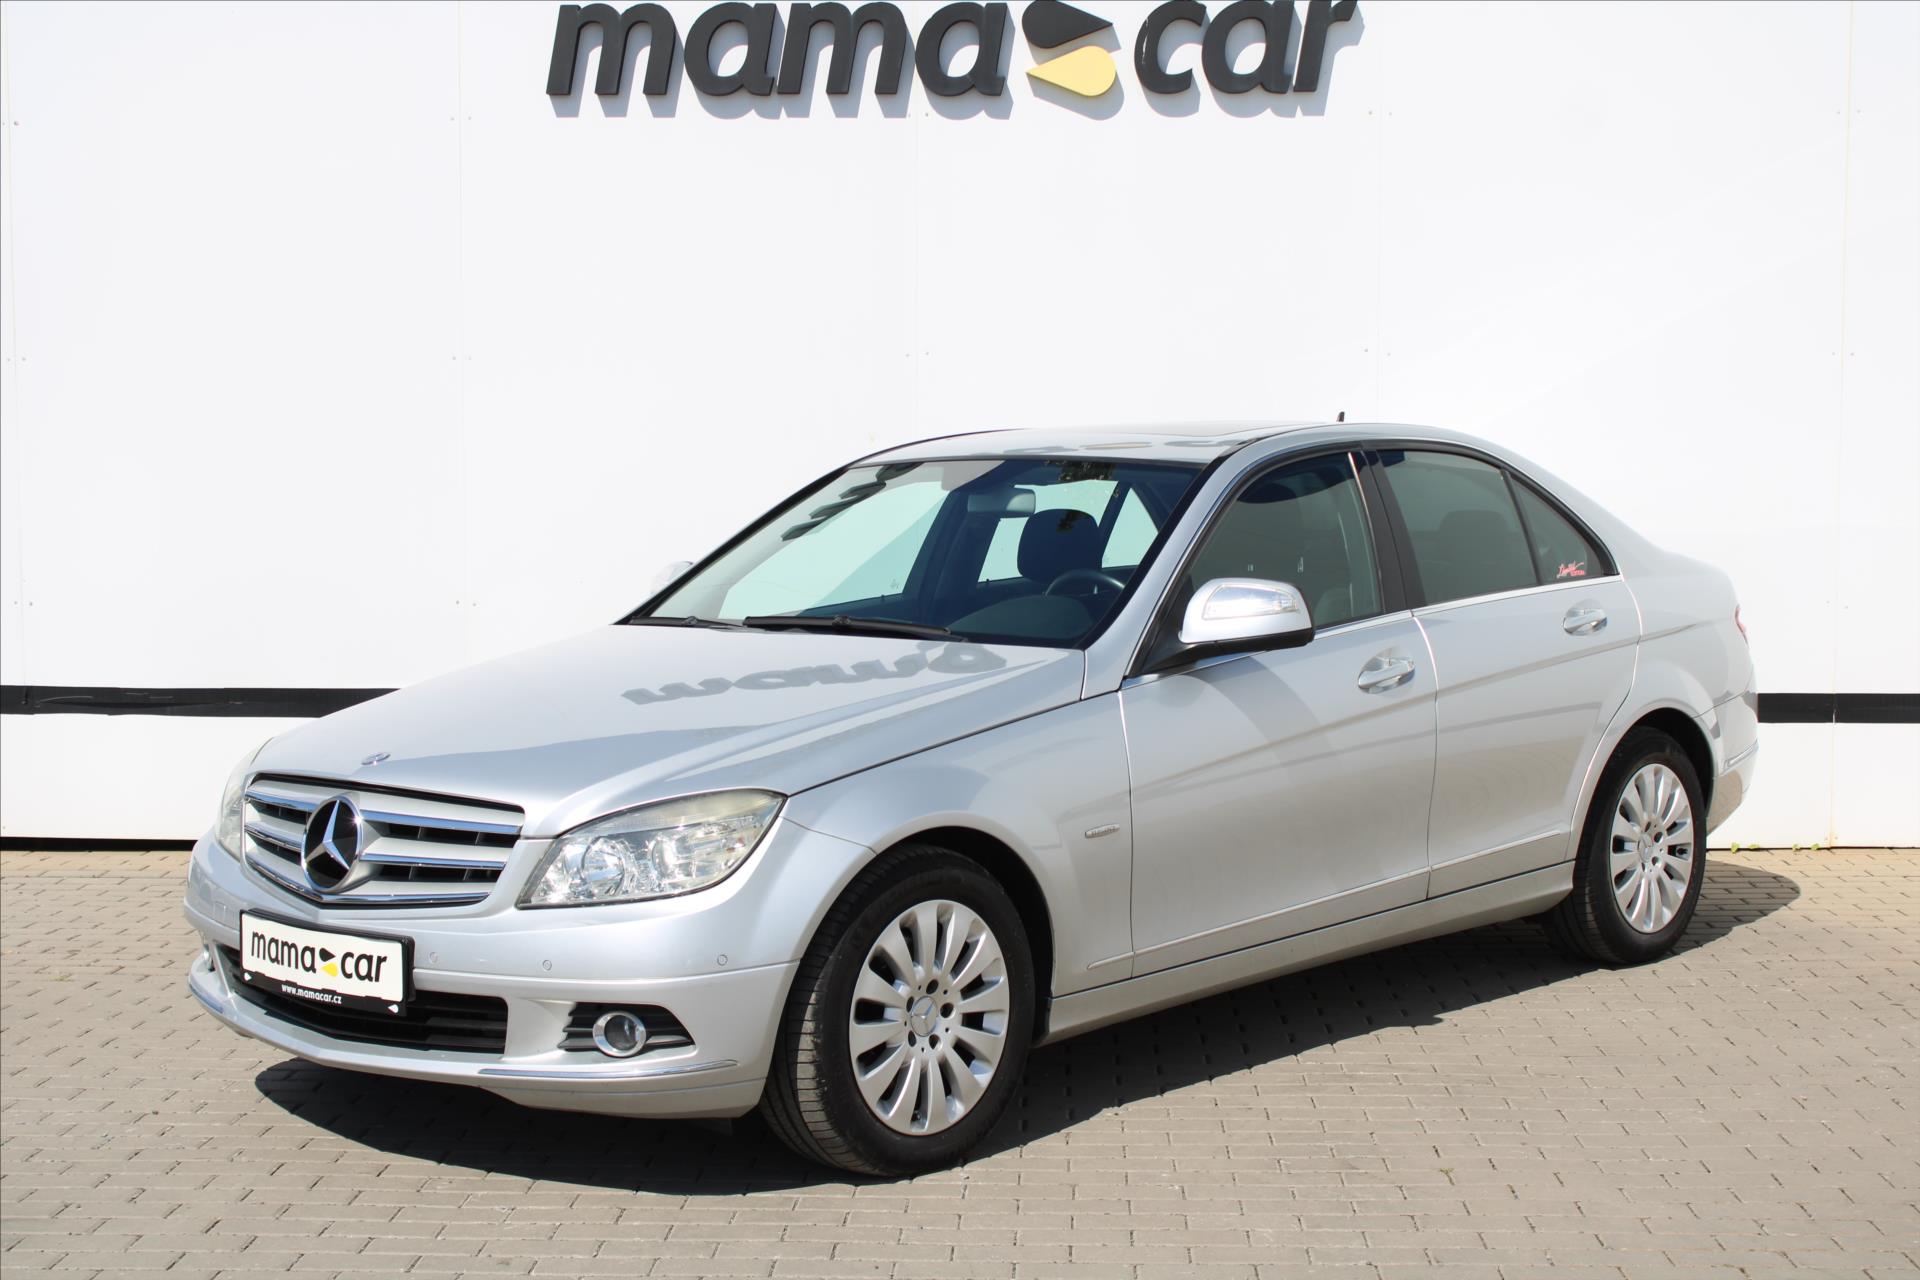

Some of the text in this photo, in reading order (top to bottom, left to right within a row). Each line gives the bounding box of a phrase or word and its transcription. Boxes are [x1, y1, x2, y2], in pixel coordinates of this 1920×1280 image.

[546, 0, 1357, 96] mama car
[251, 931, 388, 983] mama car
[281, 984, 342, 1004] www.mamacar.cz
